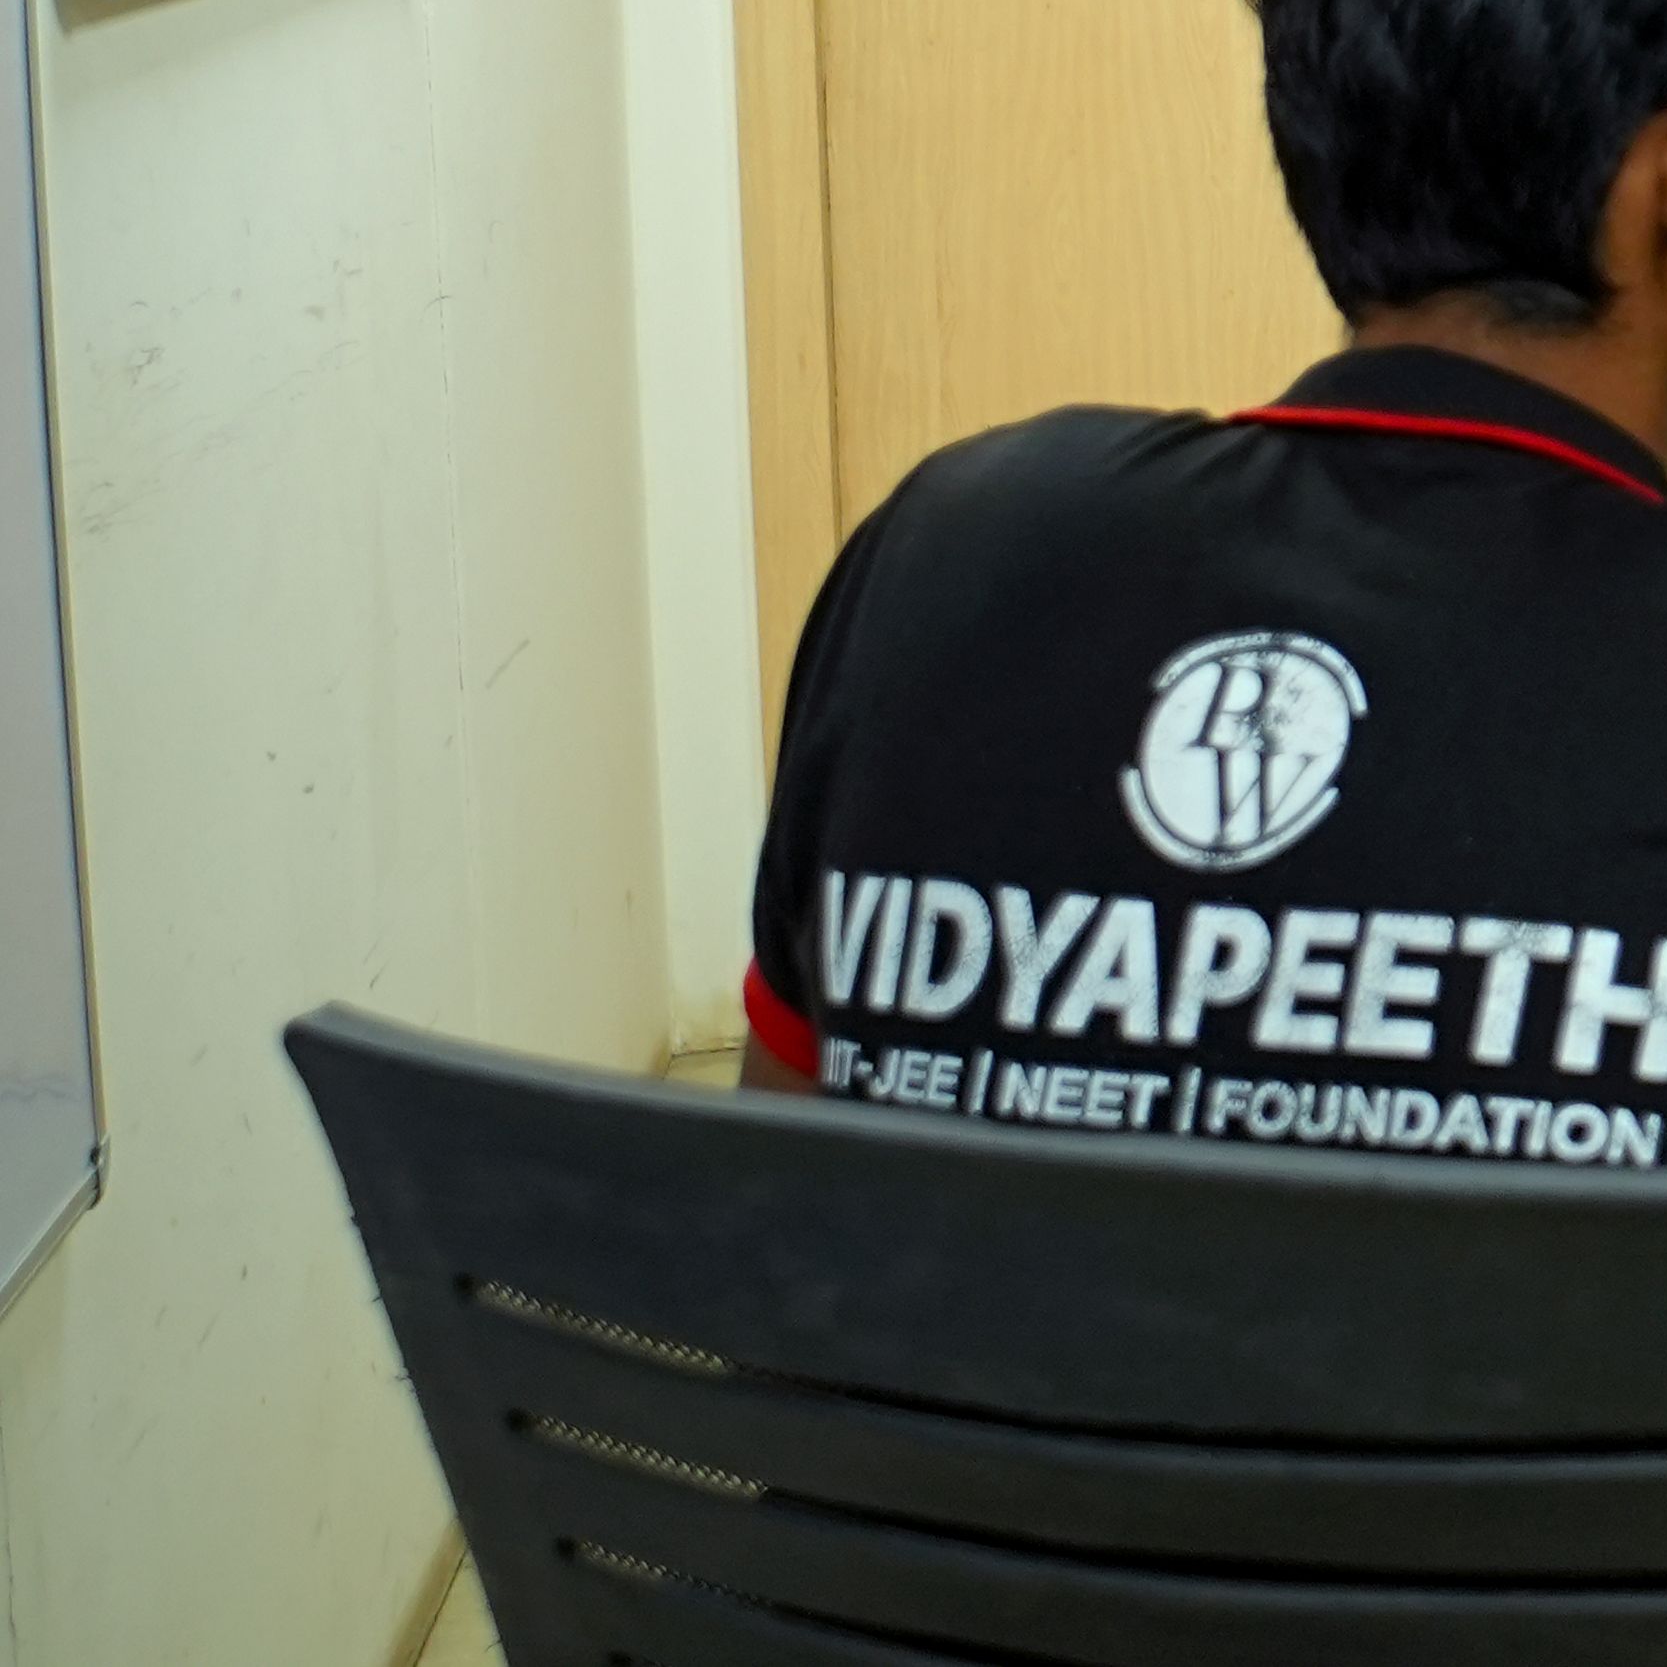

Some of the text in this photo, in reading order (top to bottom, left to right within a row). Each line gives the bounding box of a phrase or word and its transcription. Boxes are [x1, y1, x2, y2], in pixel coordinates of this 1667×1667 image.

[821, 1036, 1665, 1168] IIT-JEE NEET FOUNDATION
